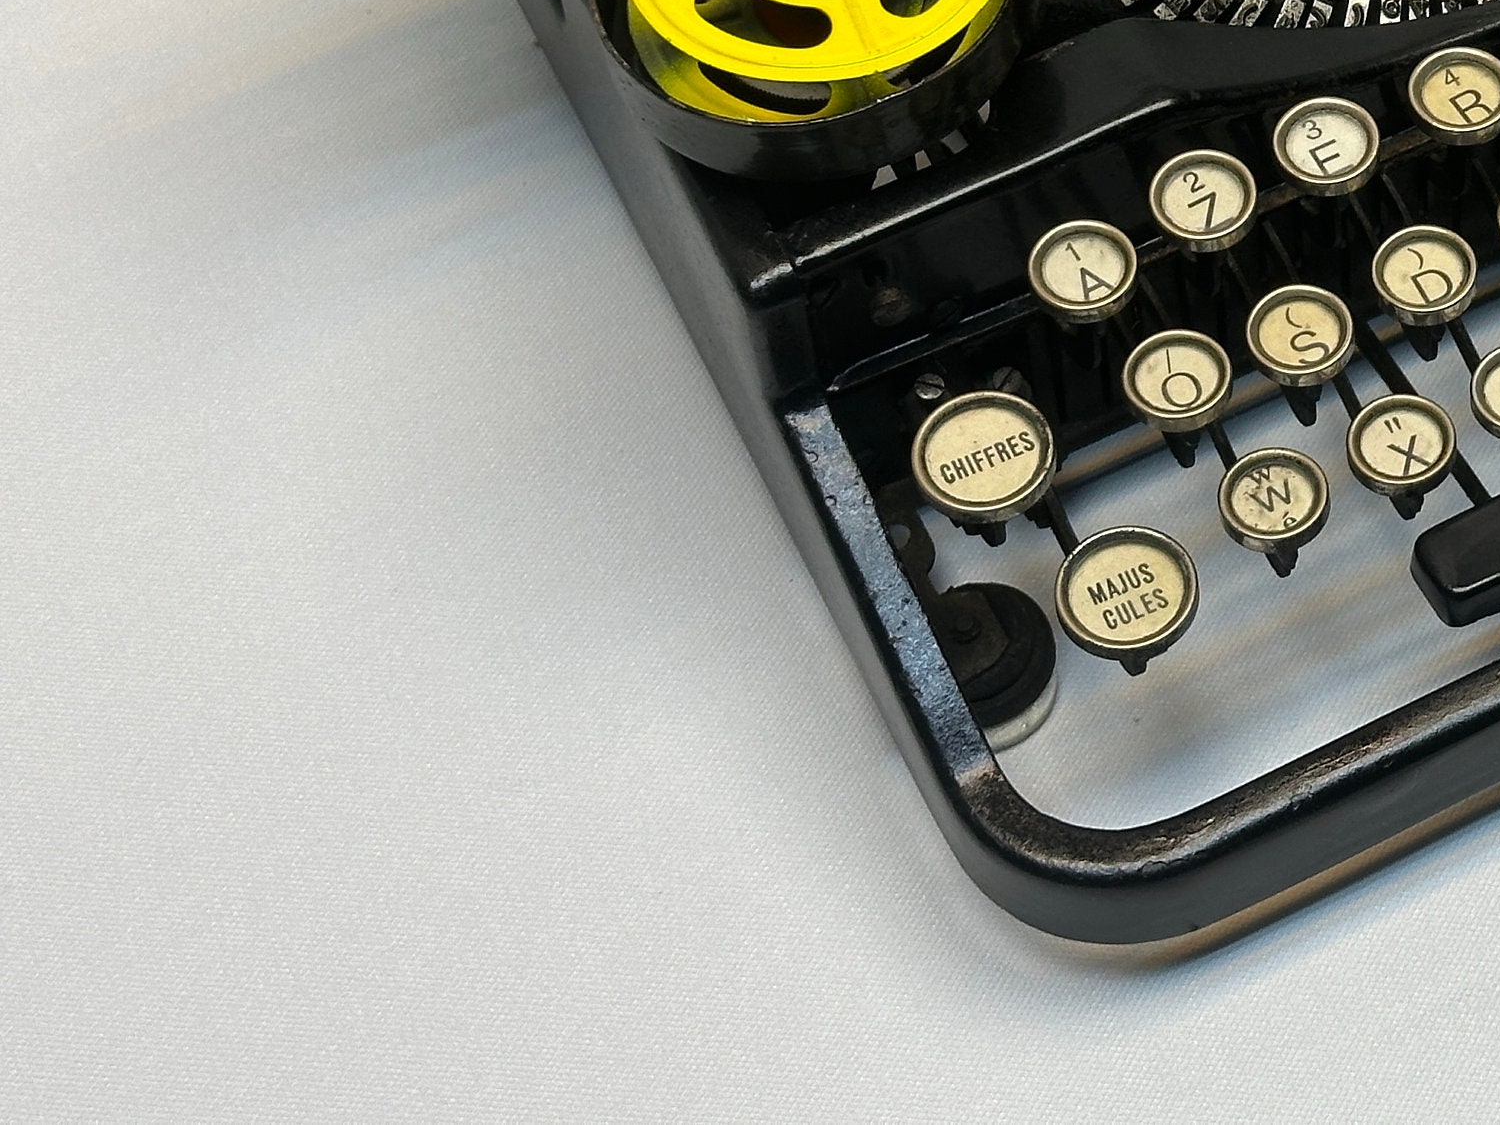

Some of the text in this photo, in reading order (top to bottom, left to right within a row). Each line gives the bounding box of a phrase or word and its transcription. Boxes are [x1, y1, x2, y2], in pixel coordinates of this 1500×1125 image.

[1444, 68, 1460, 86] 4
[1449, 89, 1493, 124] R
[1303, 120, 1322, 139] 3
[1182, 172, 1205, 193] 2
[1065, 242, 1081, 262] 1
[1406, 247, 1424, 270] )
[1080, 267, 1113, 300] A
[1410, 269, 1453, 304] D
[1286, 307, 1302, 328] (
[1291, 331, 1330, 364] S
[939, 430, 1036, 486] CHIFFRES
[1386, 434, 1432, 475] X
[1248, 478, 1291, 513] W
[1087, 562, 1155, 606] MAJUS
[1101, 587, 1169, 632] CULES
